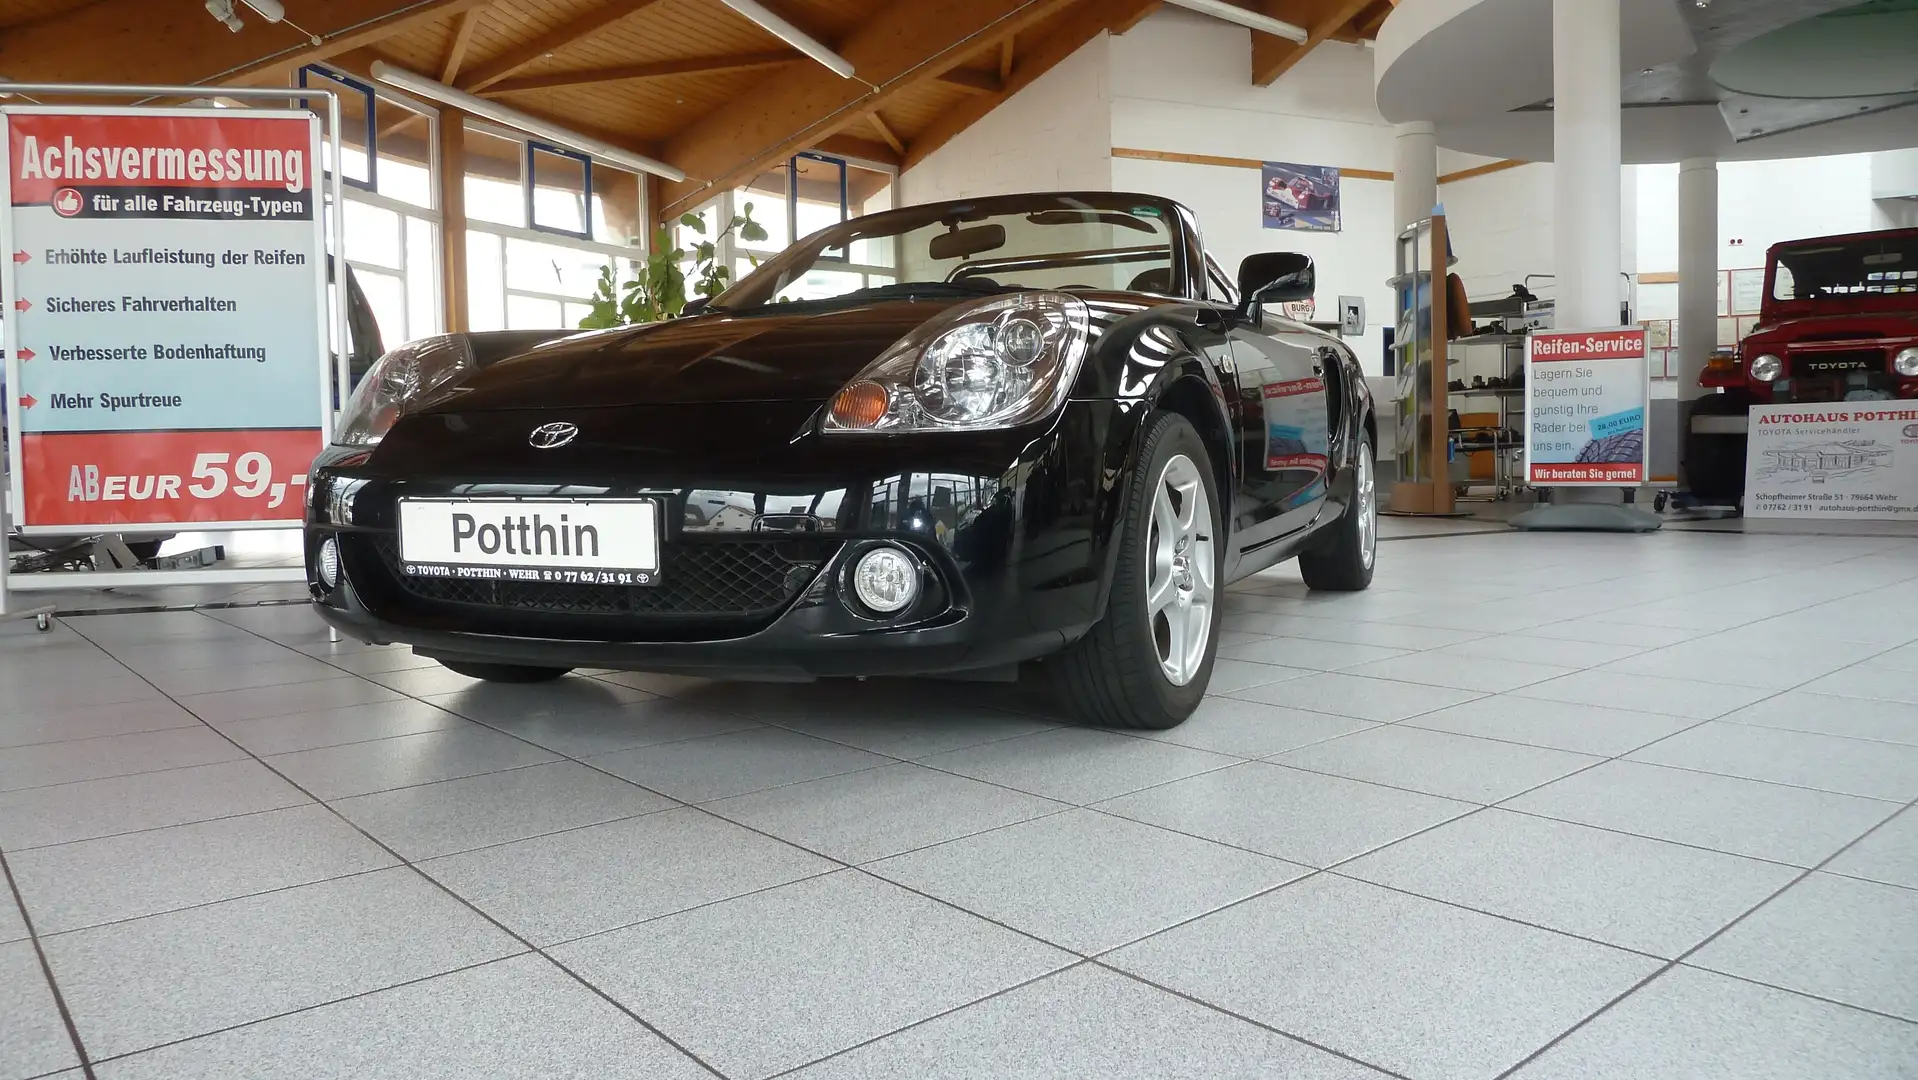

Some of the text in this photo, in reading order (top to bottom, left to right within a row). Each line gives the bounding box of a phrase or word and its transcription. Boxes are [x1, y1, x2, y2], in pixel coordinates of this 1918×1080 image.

[21, 135, 304, 192] Achsvermessung
[93, 194, 303, 217] für alle Fahrzeug-Typen
[45, 249, 306, 269] Erhöhte Laufleistung der Reifen
[46, 296, 237, 313] Sicheres Fahrverhalten
[49, 344, 266, 363] Verbesserte Bodenhaftung
[1533, 336, 1643, 356] Reifen-Service
[1808, 361, 1867, 370] TOYOTA
[1533, 367, 1593, 382] Lagern Sie
[1533, 385, 1603, 400] bequem und
[50, 393, 182, 412] Mehr Spurtreue
[1577, 404, 1599, 415] Ihre
[1619, 414, 1641, 425] EURO
[1759, 410, 1918, 425] AUTOHAUS POTTHI
[1569, 422, 1586, 433] bei
[1795, 427, 1861, 436] Servicehändler
[1533, 441, 1575, 451] uns ein.
[1535, 468, 1636, 481] Wir beraten Sie gerne!
[68, 465, 100, 502] AB
[102, 475, 182, 501] EUR
[1755, 493, 1806, 503] Schopfheimer
[1808, 493, 1833, 501] Straße
[1834, 493, 1844, 501] 51
[1875, 493, 1898, 501] Wehr
[1762, 503, 1786, 512] 07762
[1818, 505, 1918, 513] autohaus-potthin@gmx.d
[452, 513, 599, 557] Potthin
[417, 565, 451, 576] TOYOTA
[457, 567, 502, 578] POTTHIN
[509, 569, 540, 580] WEHR
[555, 571, 562, 581] 0
[564, 571, 578, 582] 77
[618, 573, 633, 583] 91
